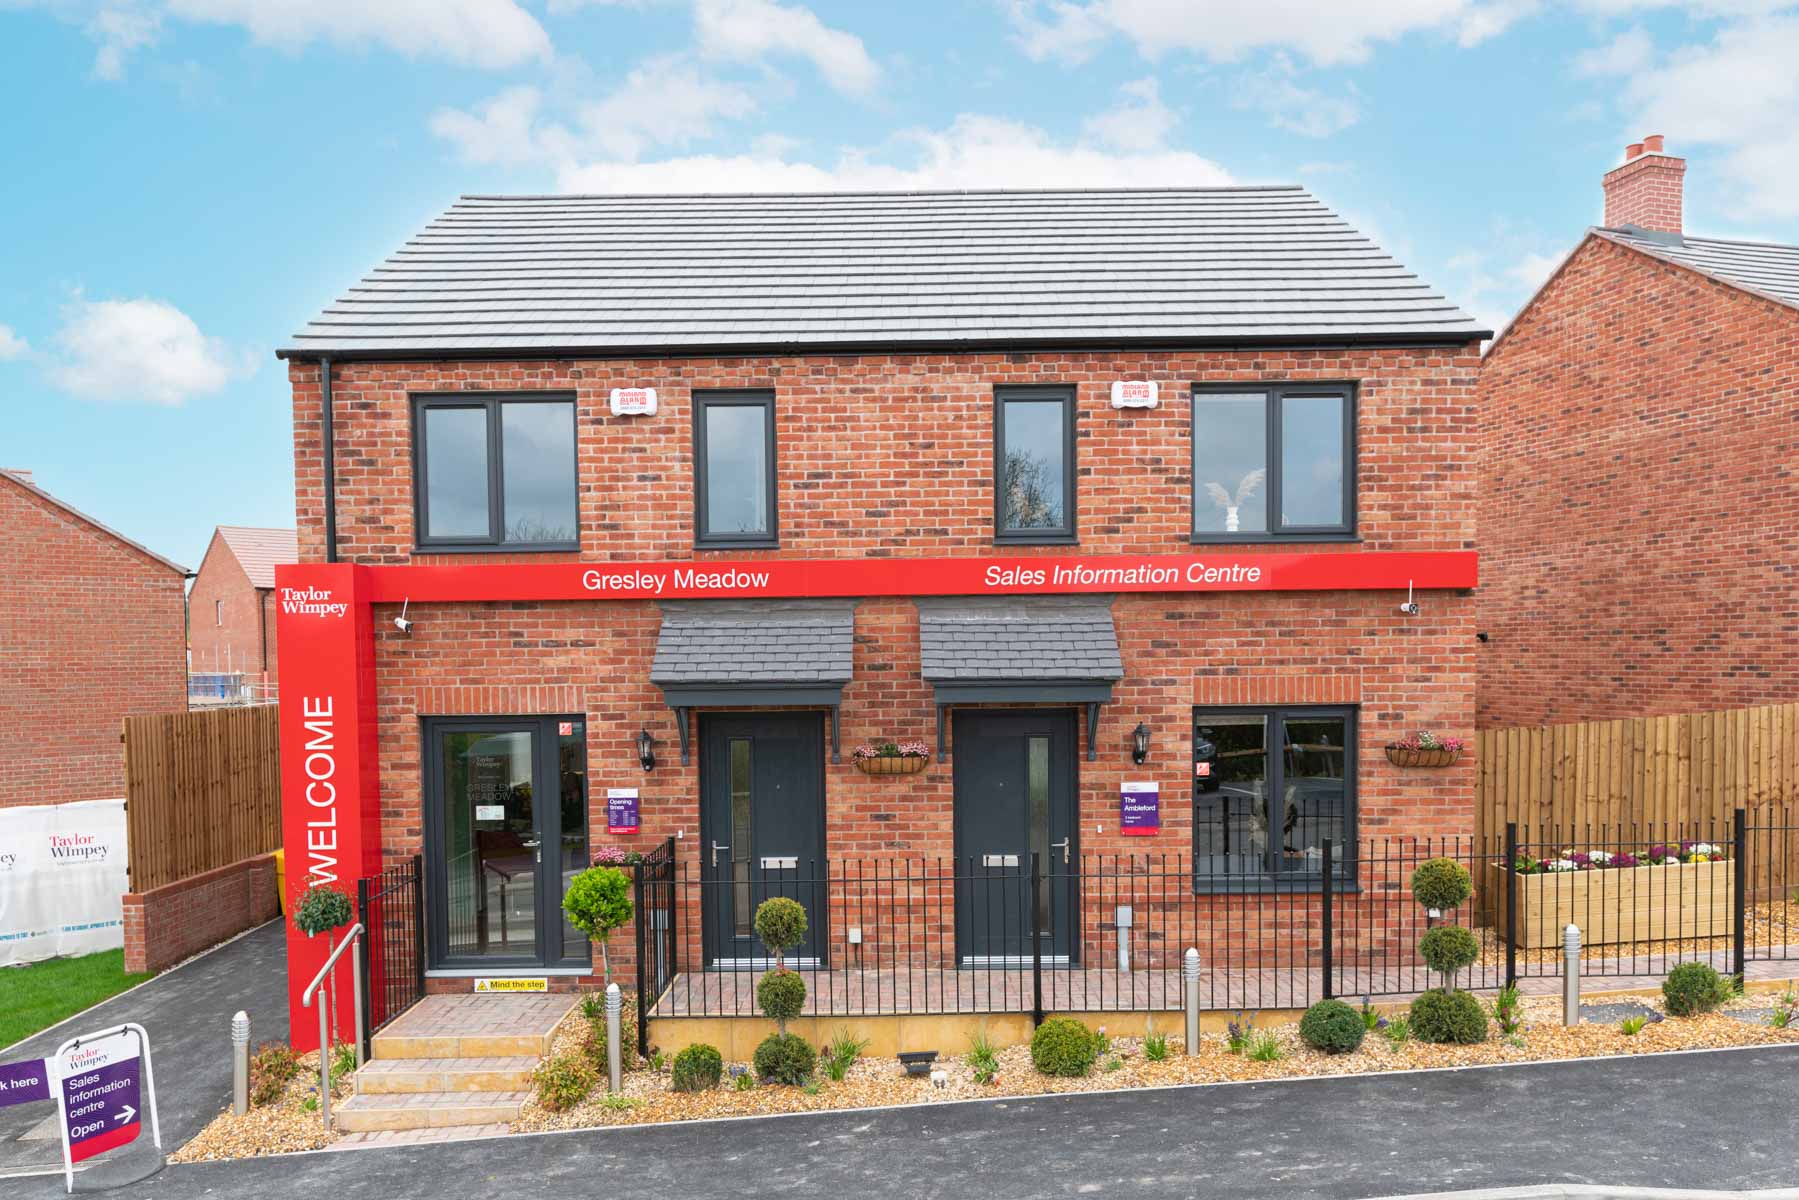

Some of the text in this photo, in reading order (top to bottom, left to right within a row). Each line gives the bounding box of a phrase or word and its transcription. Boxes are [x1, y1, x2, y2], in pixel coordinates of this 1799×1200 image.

[582, 568, 770, 594] Gresley Meadow
[984, 562, 1261, 586] Sales Information Centre
[280, 586, 332, 604] Taylor
[281, 600, 348, 618] Wimpey
[303, 696, 338, 888] WELCOME
[466, 792, 512, 801] MEADOW
[49, 832, 95, 848] Taylor
[51, 846, 109, 859] Wimpey
[490, 981, 510, 989] Mind
[527, 981, 545, 989] step
[69, 1054, 108, 1070] Wimpey
[70, 1048, 99, 1063] Taylor
[10, 1077, 39, 1089] here
[69, 1073, 100, 1090] Sales
[69, 1078, 131, 1104] information
[69, 1101, 105, 1119] centre
[71, 1119, 104, 1139] Open
